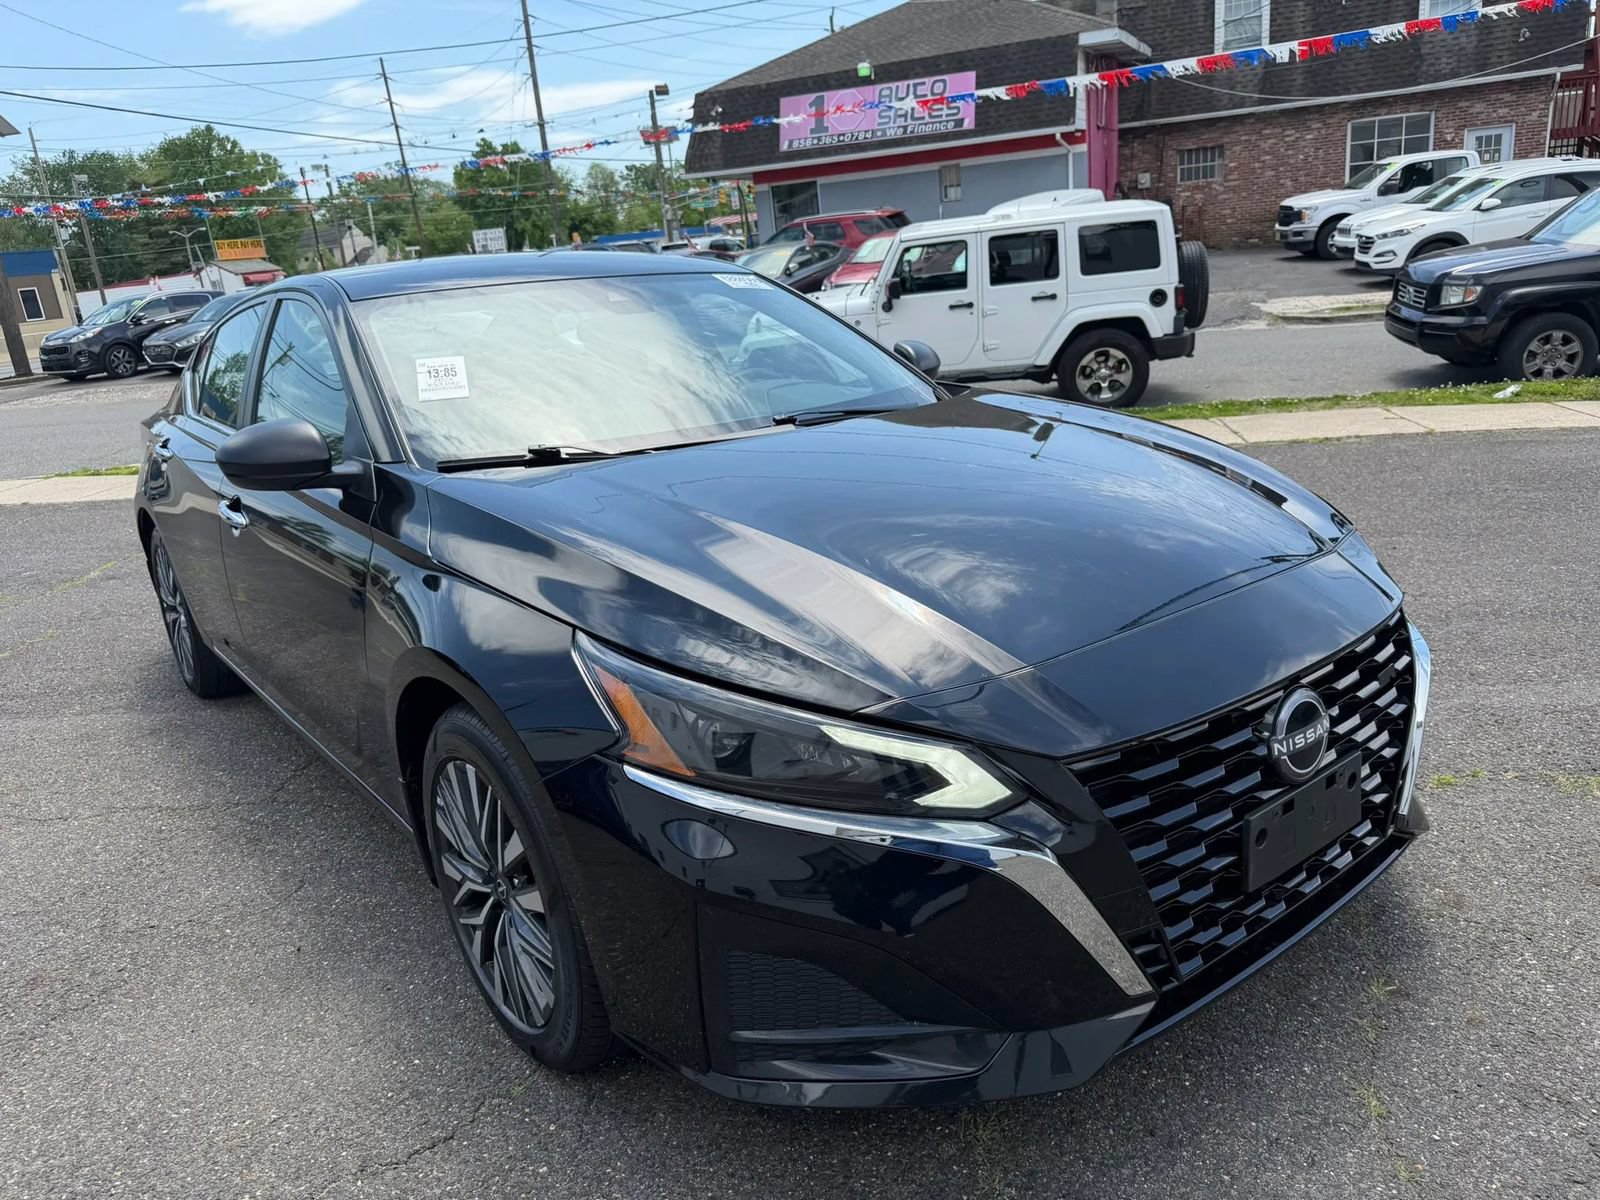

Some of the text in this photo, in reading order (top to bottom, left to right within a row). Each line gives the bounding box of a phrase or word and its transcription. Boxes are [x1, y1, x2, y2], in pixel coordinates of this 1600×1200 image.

[878, 78, 948, 103] AUTO
[876, 101, 962, 127] SALES
[886, 125, 904, 137] We
[907, 121, 955, 134] Finance
[216, 240, 263, 250] BUY HERE PAY HERE
[427, 367, 457, 379] 13:85
[1274, 719, 1329, 756] NISSAN
